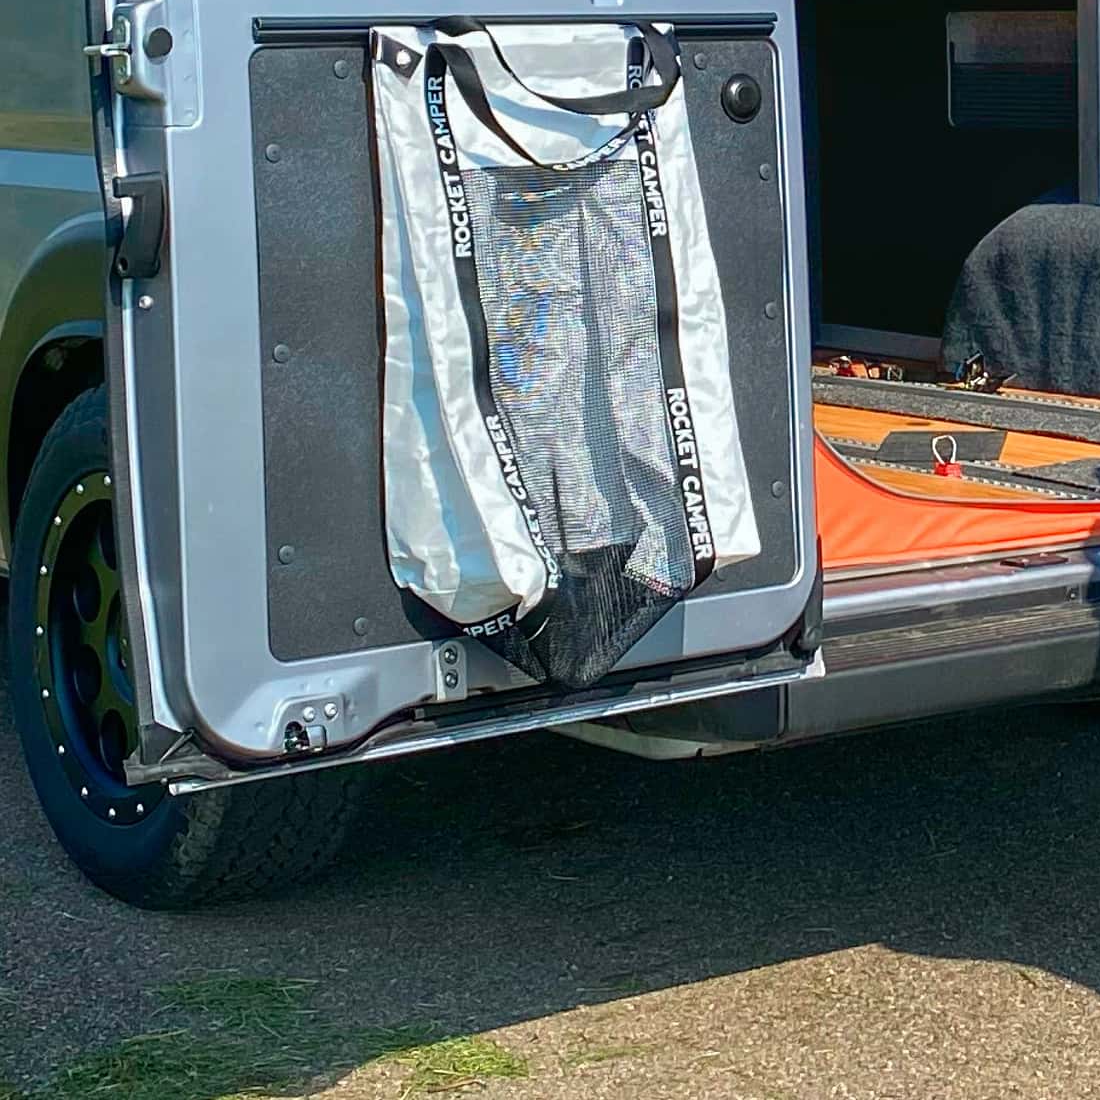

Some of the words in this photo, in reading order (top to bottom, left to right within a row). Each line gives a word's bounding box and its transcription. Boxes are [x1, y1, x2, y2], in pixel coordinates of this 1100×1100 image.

[427, 76, 457, 164] CAMPER
[443, 171, 473, 258] ROCKET
[639, 151, 667, 237] CAMPER
[486, 414, 527, 500] CAMPER
[667, 387, 698, 469] ROCKET
[522, 504, 563, 589] ROCKET
[682, 475, 714, 560] CAMPER
[462, 613, 514, 637] PER
